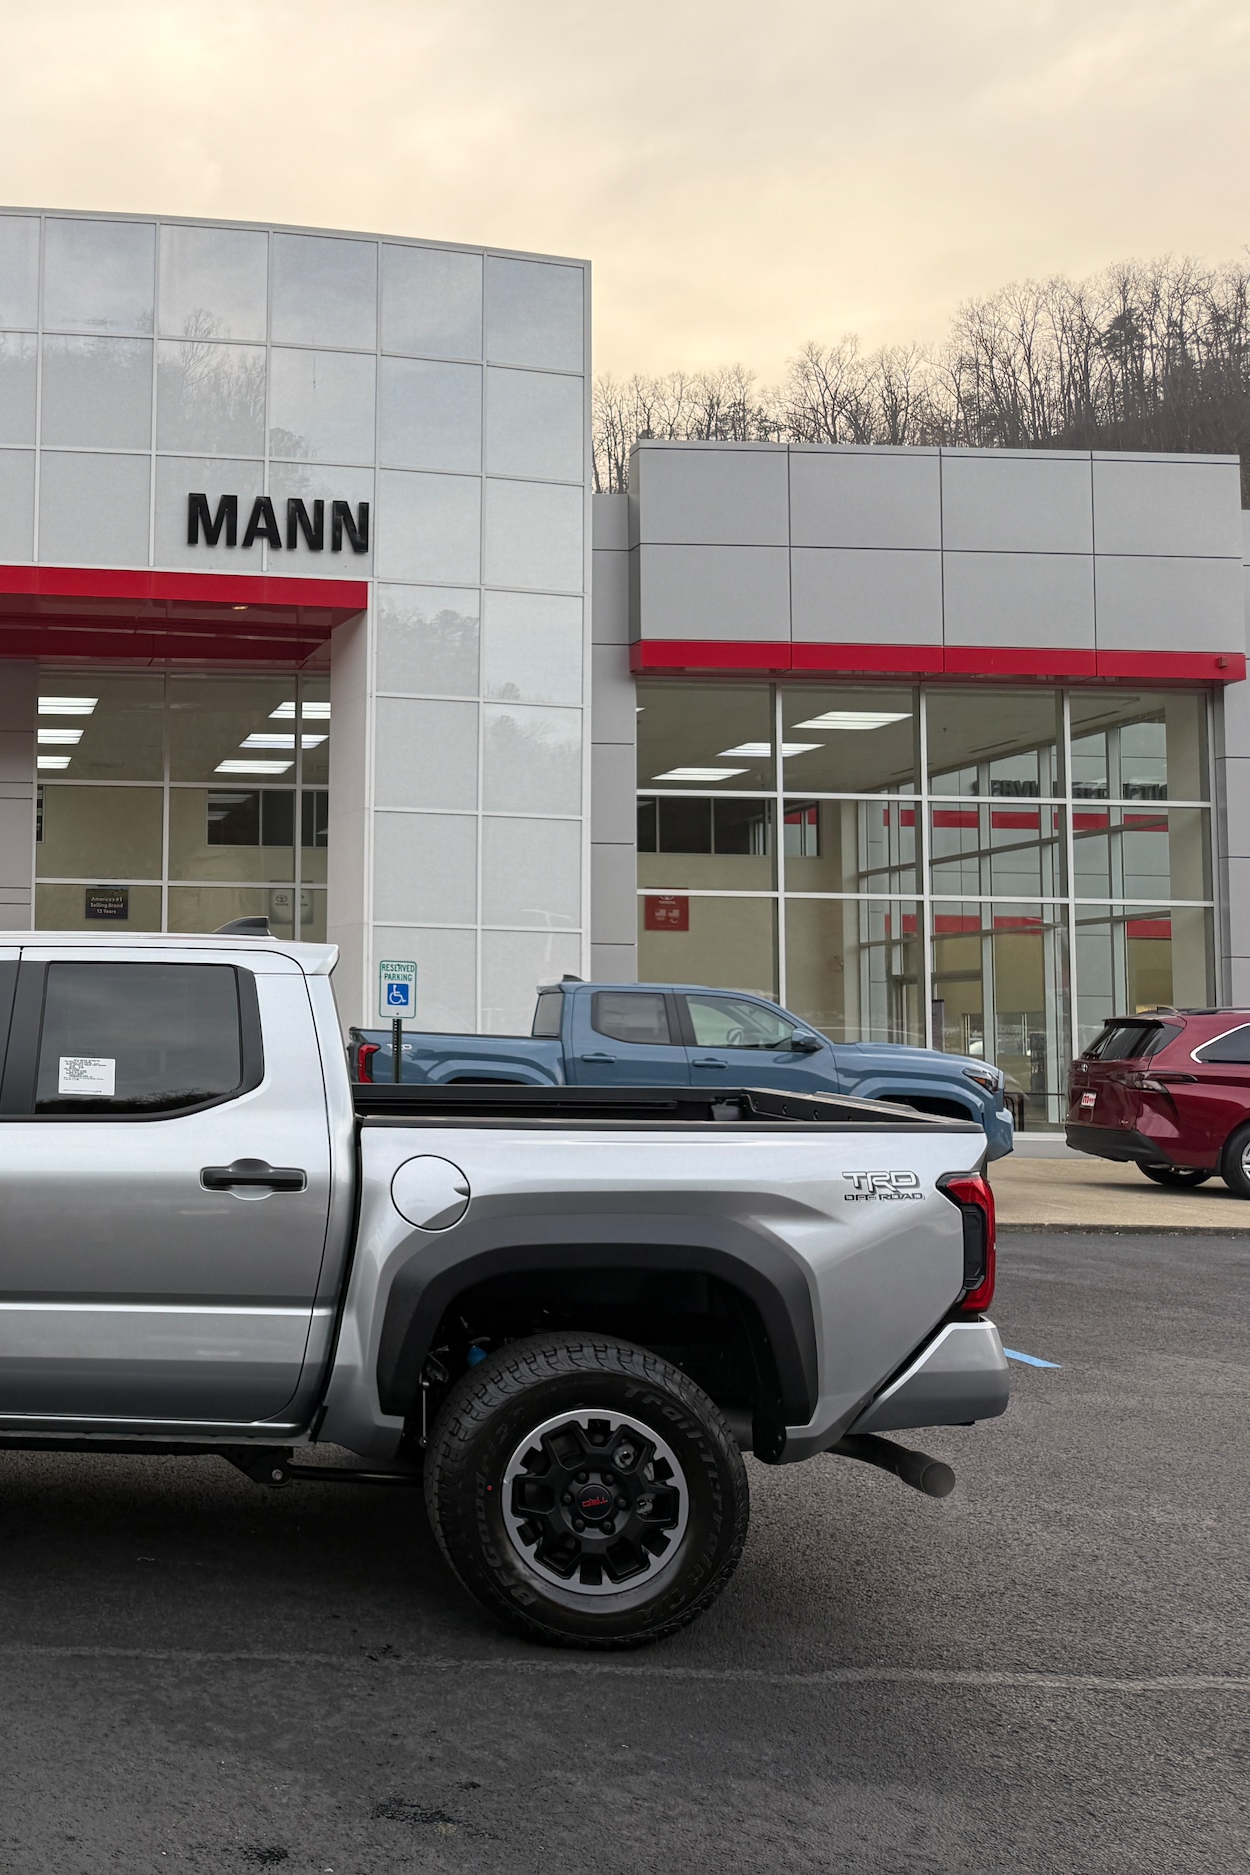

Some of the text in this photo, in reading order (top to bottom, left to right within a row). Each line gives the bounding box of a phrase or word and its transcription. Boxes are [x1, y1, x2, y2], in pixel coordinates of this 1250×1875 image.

[187, 493, 370, 553] MANN
[381, 964, 415, 973] RESERVED
[384, 973, 413, 982] PARKING
[387, 1043, 412, 1051] TD
[842, 1170, 921, 1194] TRD
[844, 1193, 925, 1202] OFF ROAD
